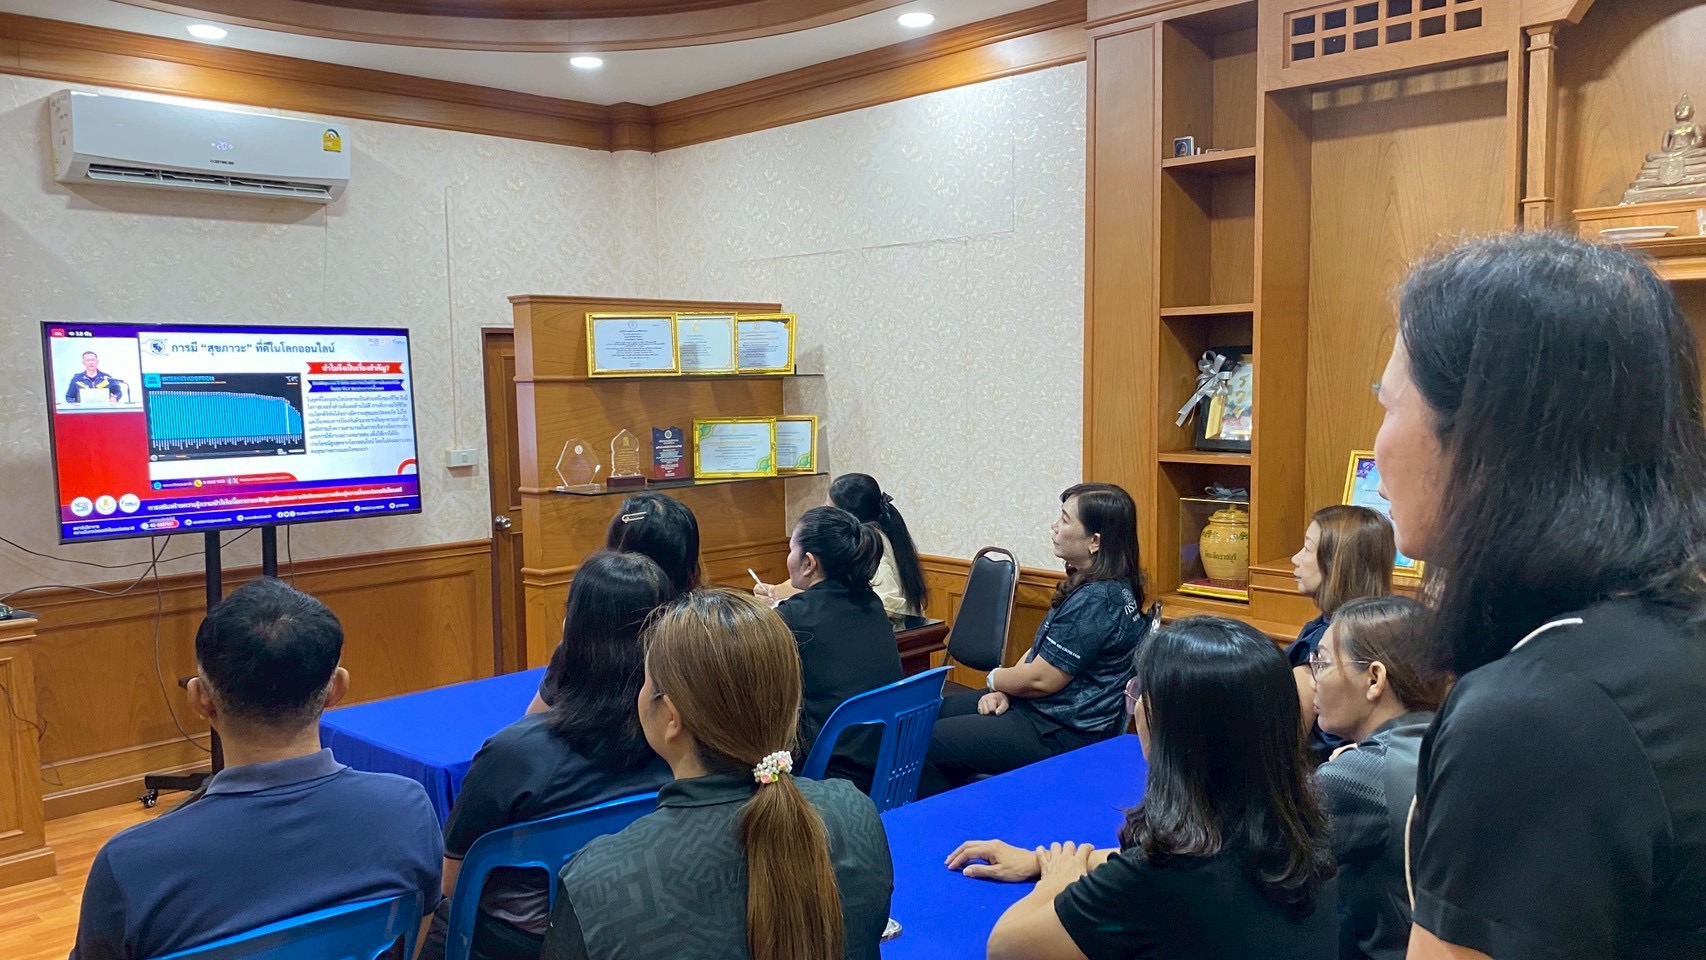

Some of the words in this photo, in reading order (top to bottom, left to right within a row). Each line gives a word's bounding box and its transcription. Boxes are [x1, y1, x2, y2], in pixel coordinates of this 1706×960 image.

[171, 341, 198, 353] การมี
[201, 343, 253, 356] “สุขภาวะ”
[256, 339, 336, 353] ที่ดีในโลกออนไลน์
